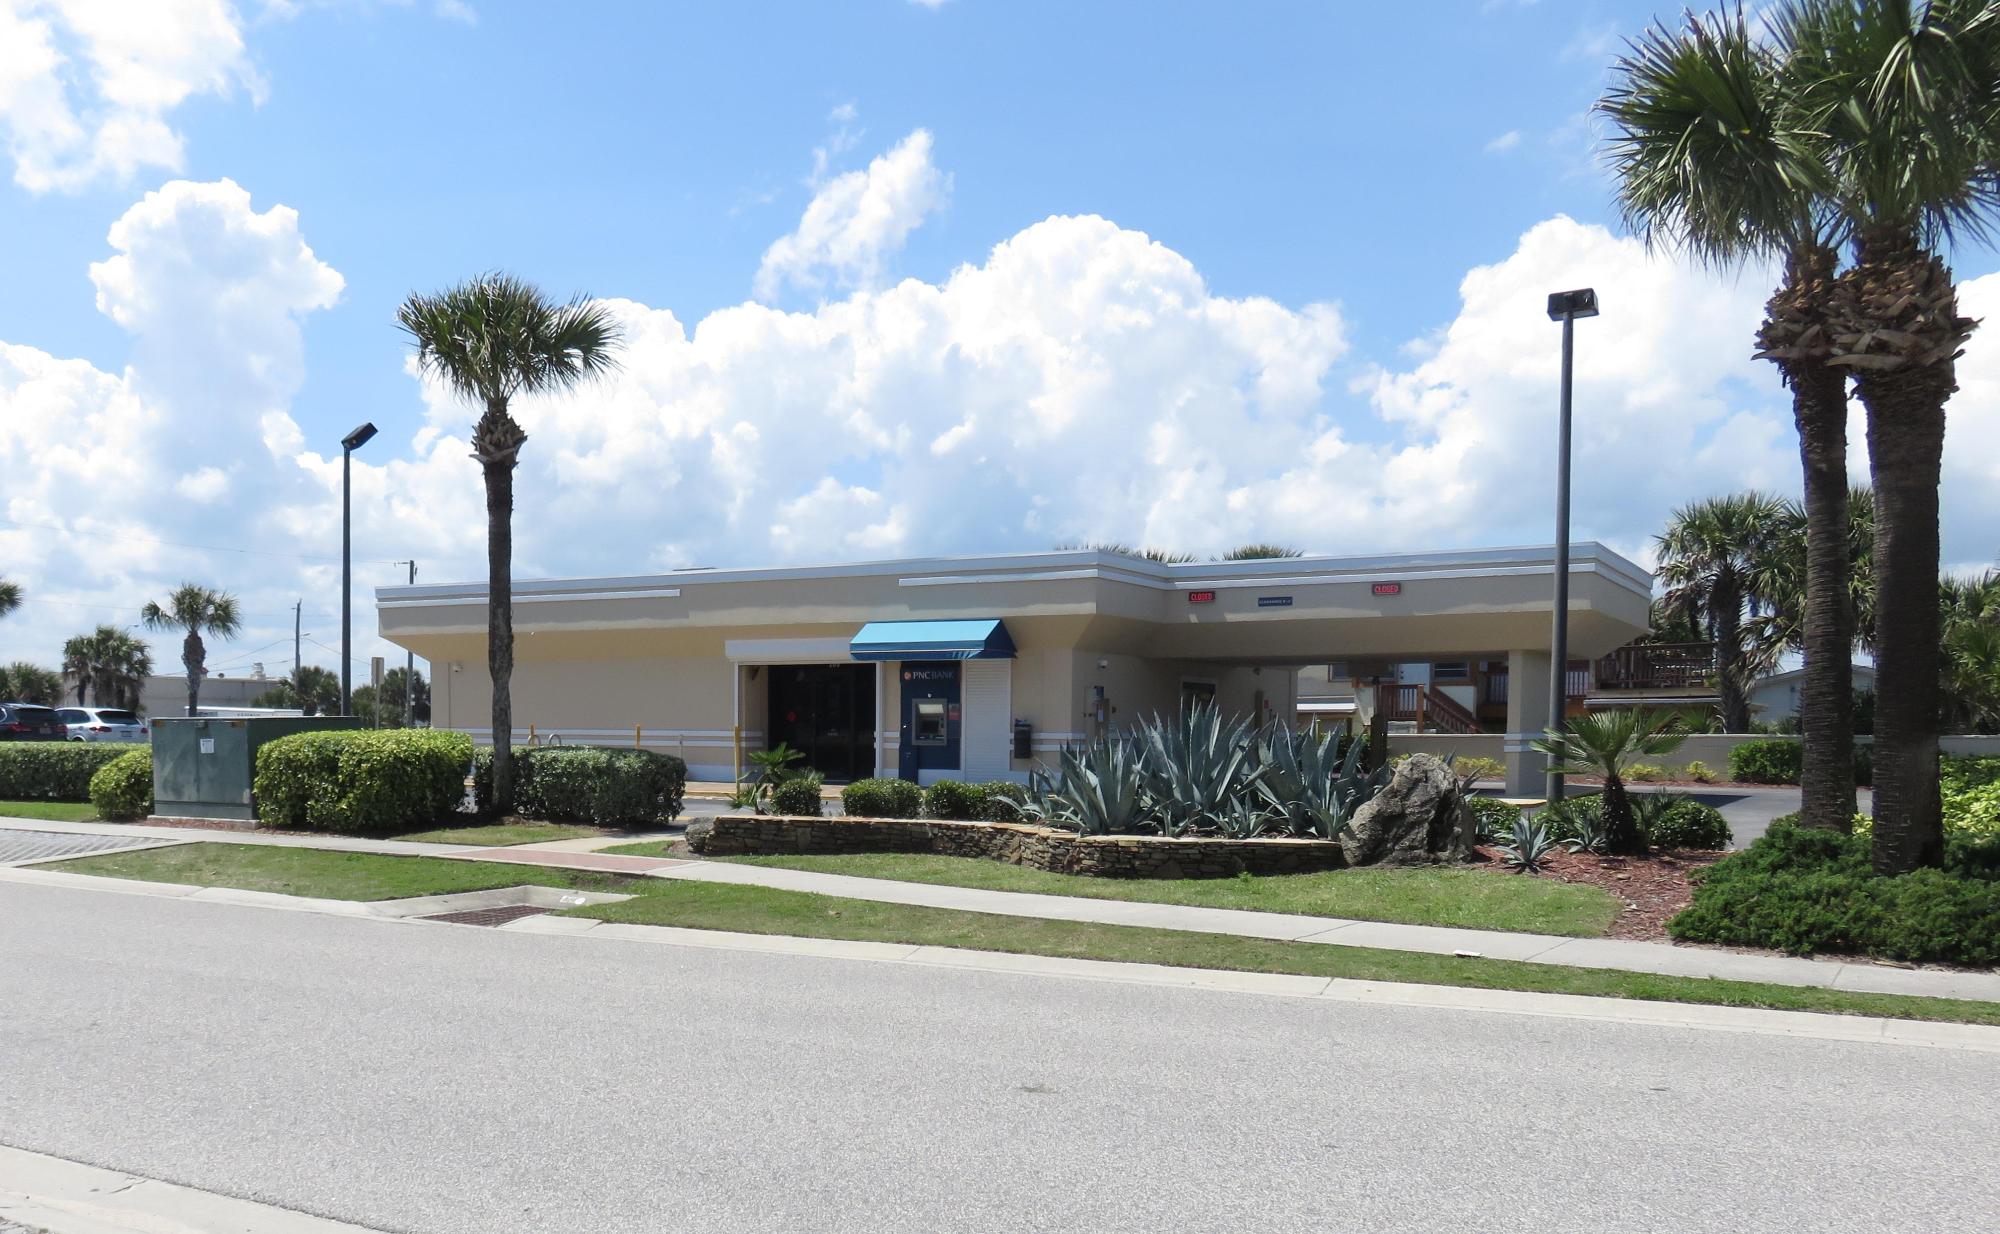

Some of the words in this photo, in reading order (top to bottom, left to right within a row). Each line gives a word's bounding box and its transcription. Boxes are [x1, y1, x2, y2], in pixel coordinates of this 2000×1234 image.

[1375, 584, 1399, 592] CLOSED
[1191, 592, 1212, 601] CLOSED
[912, 671, 930, 680] PNC
[931, 671, 954, 680] BANK
